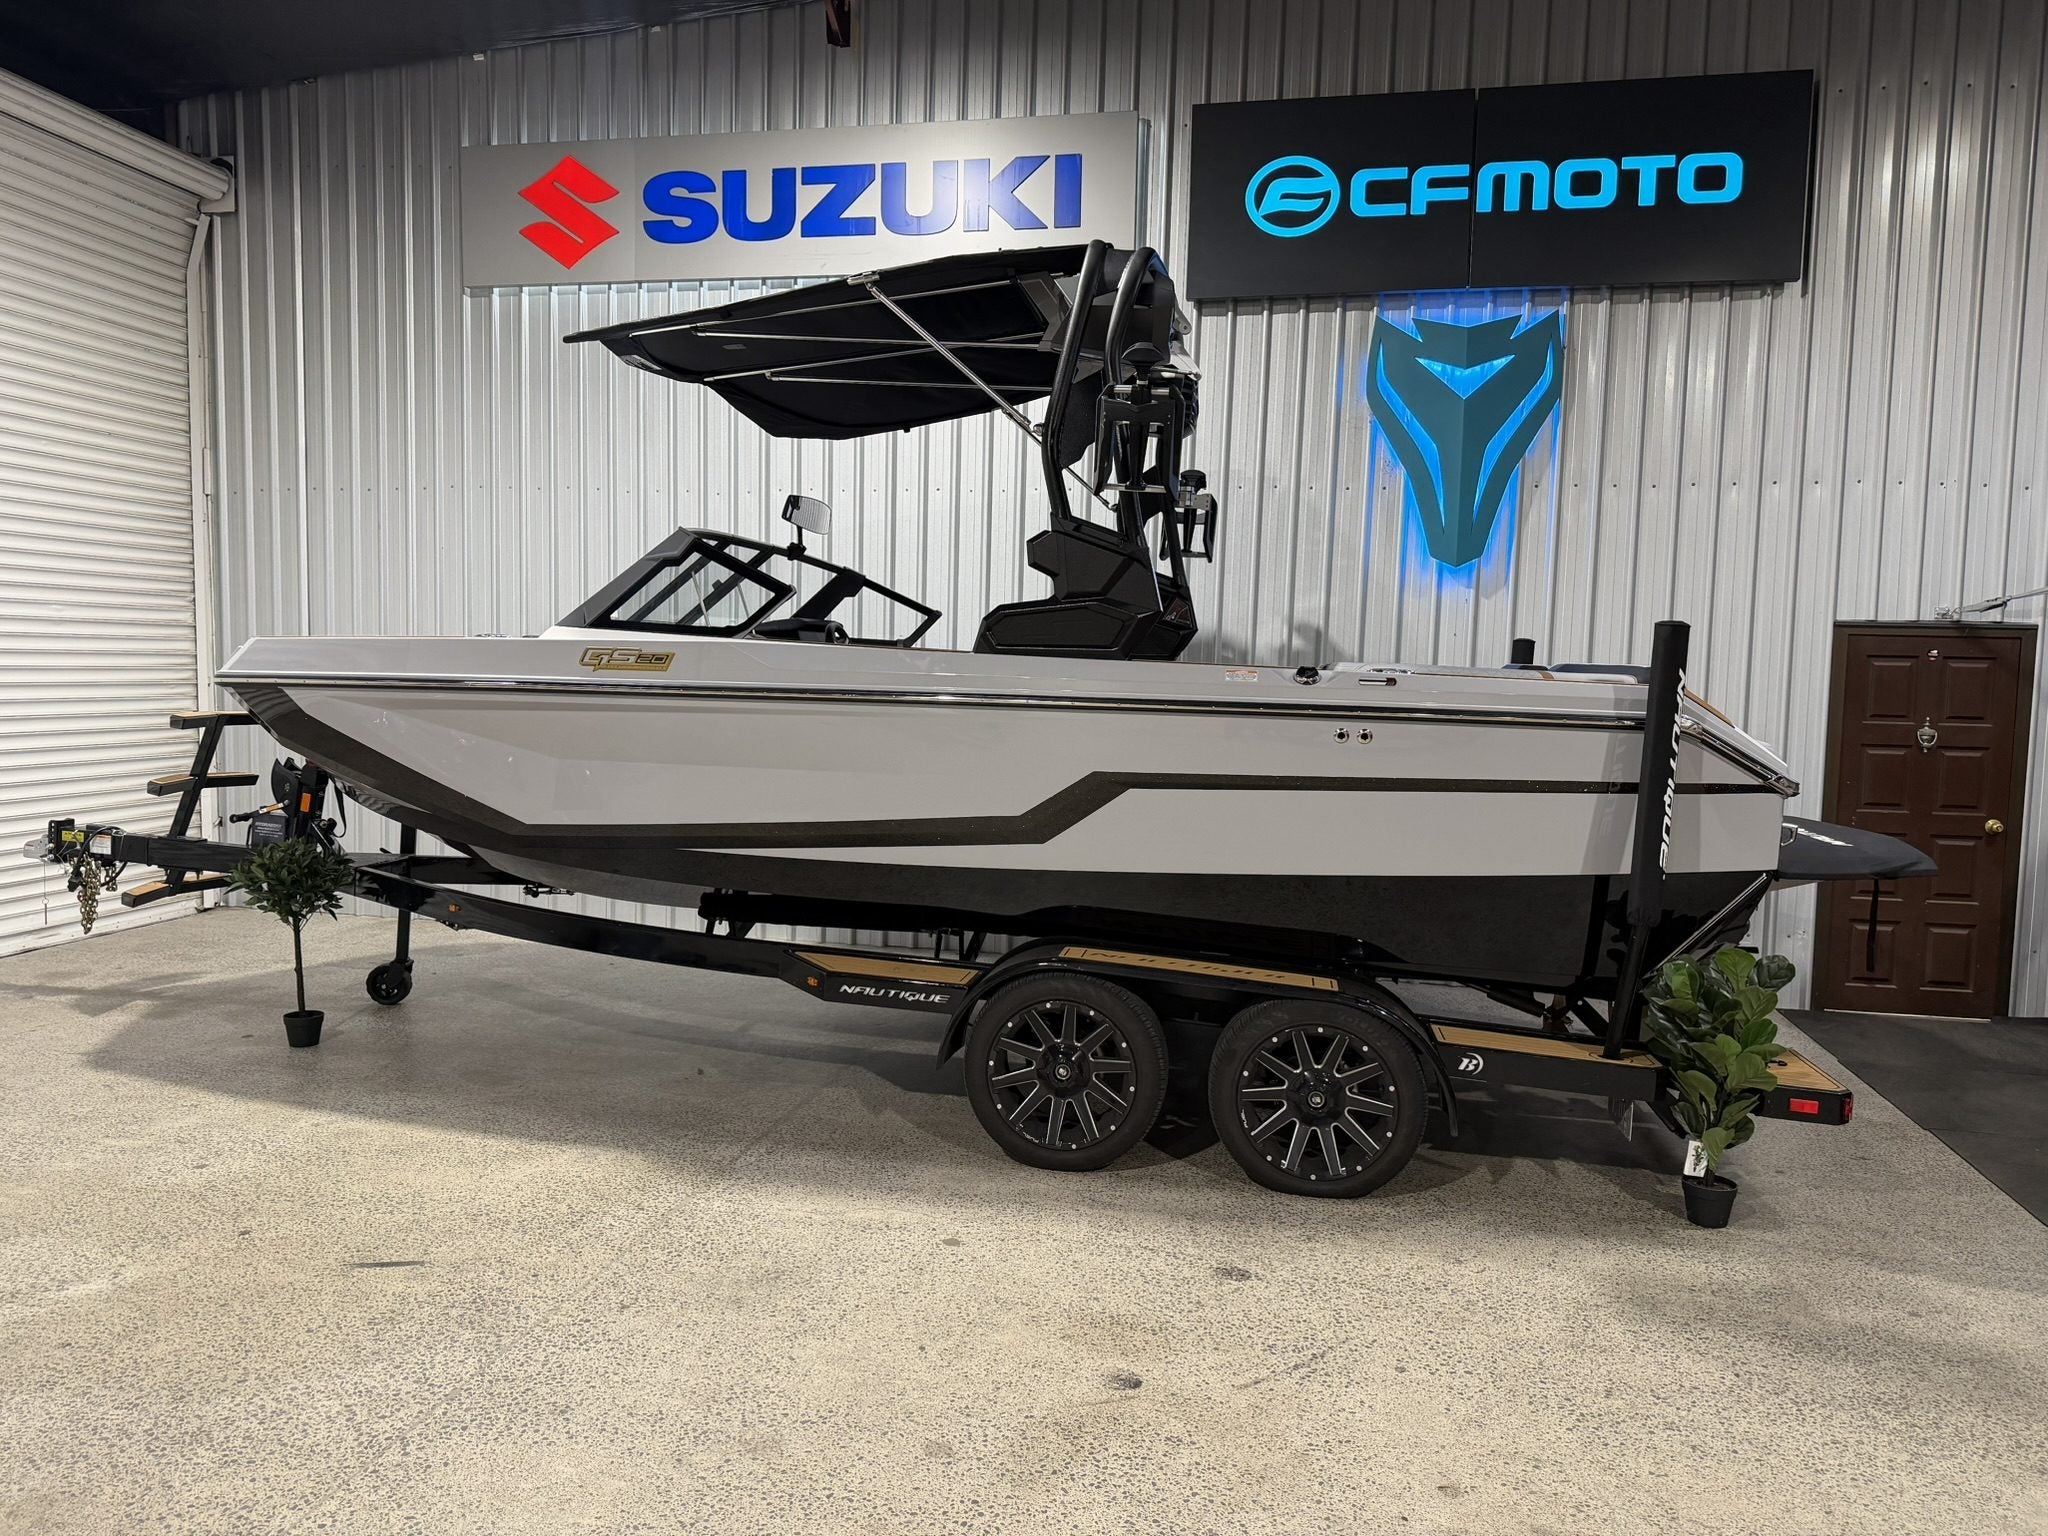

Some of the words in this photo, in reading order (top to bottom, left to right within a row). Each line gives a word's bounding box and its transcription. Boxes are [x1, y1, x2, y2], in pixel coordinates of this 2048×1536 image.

[642, 153, 1082, 244] SUZUKI
[1350, 152, 1743, 217] CFMOTO
[839, 984, 951, 1003] NAUTIQUE
